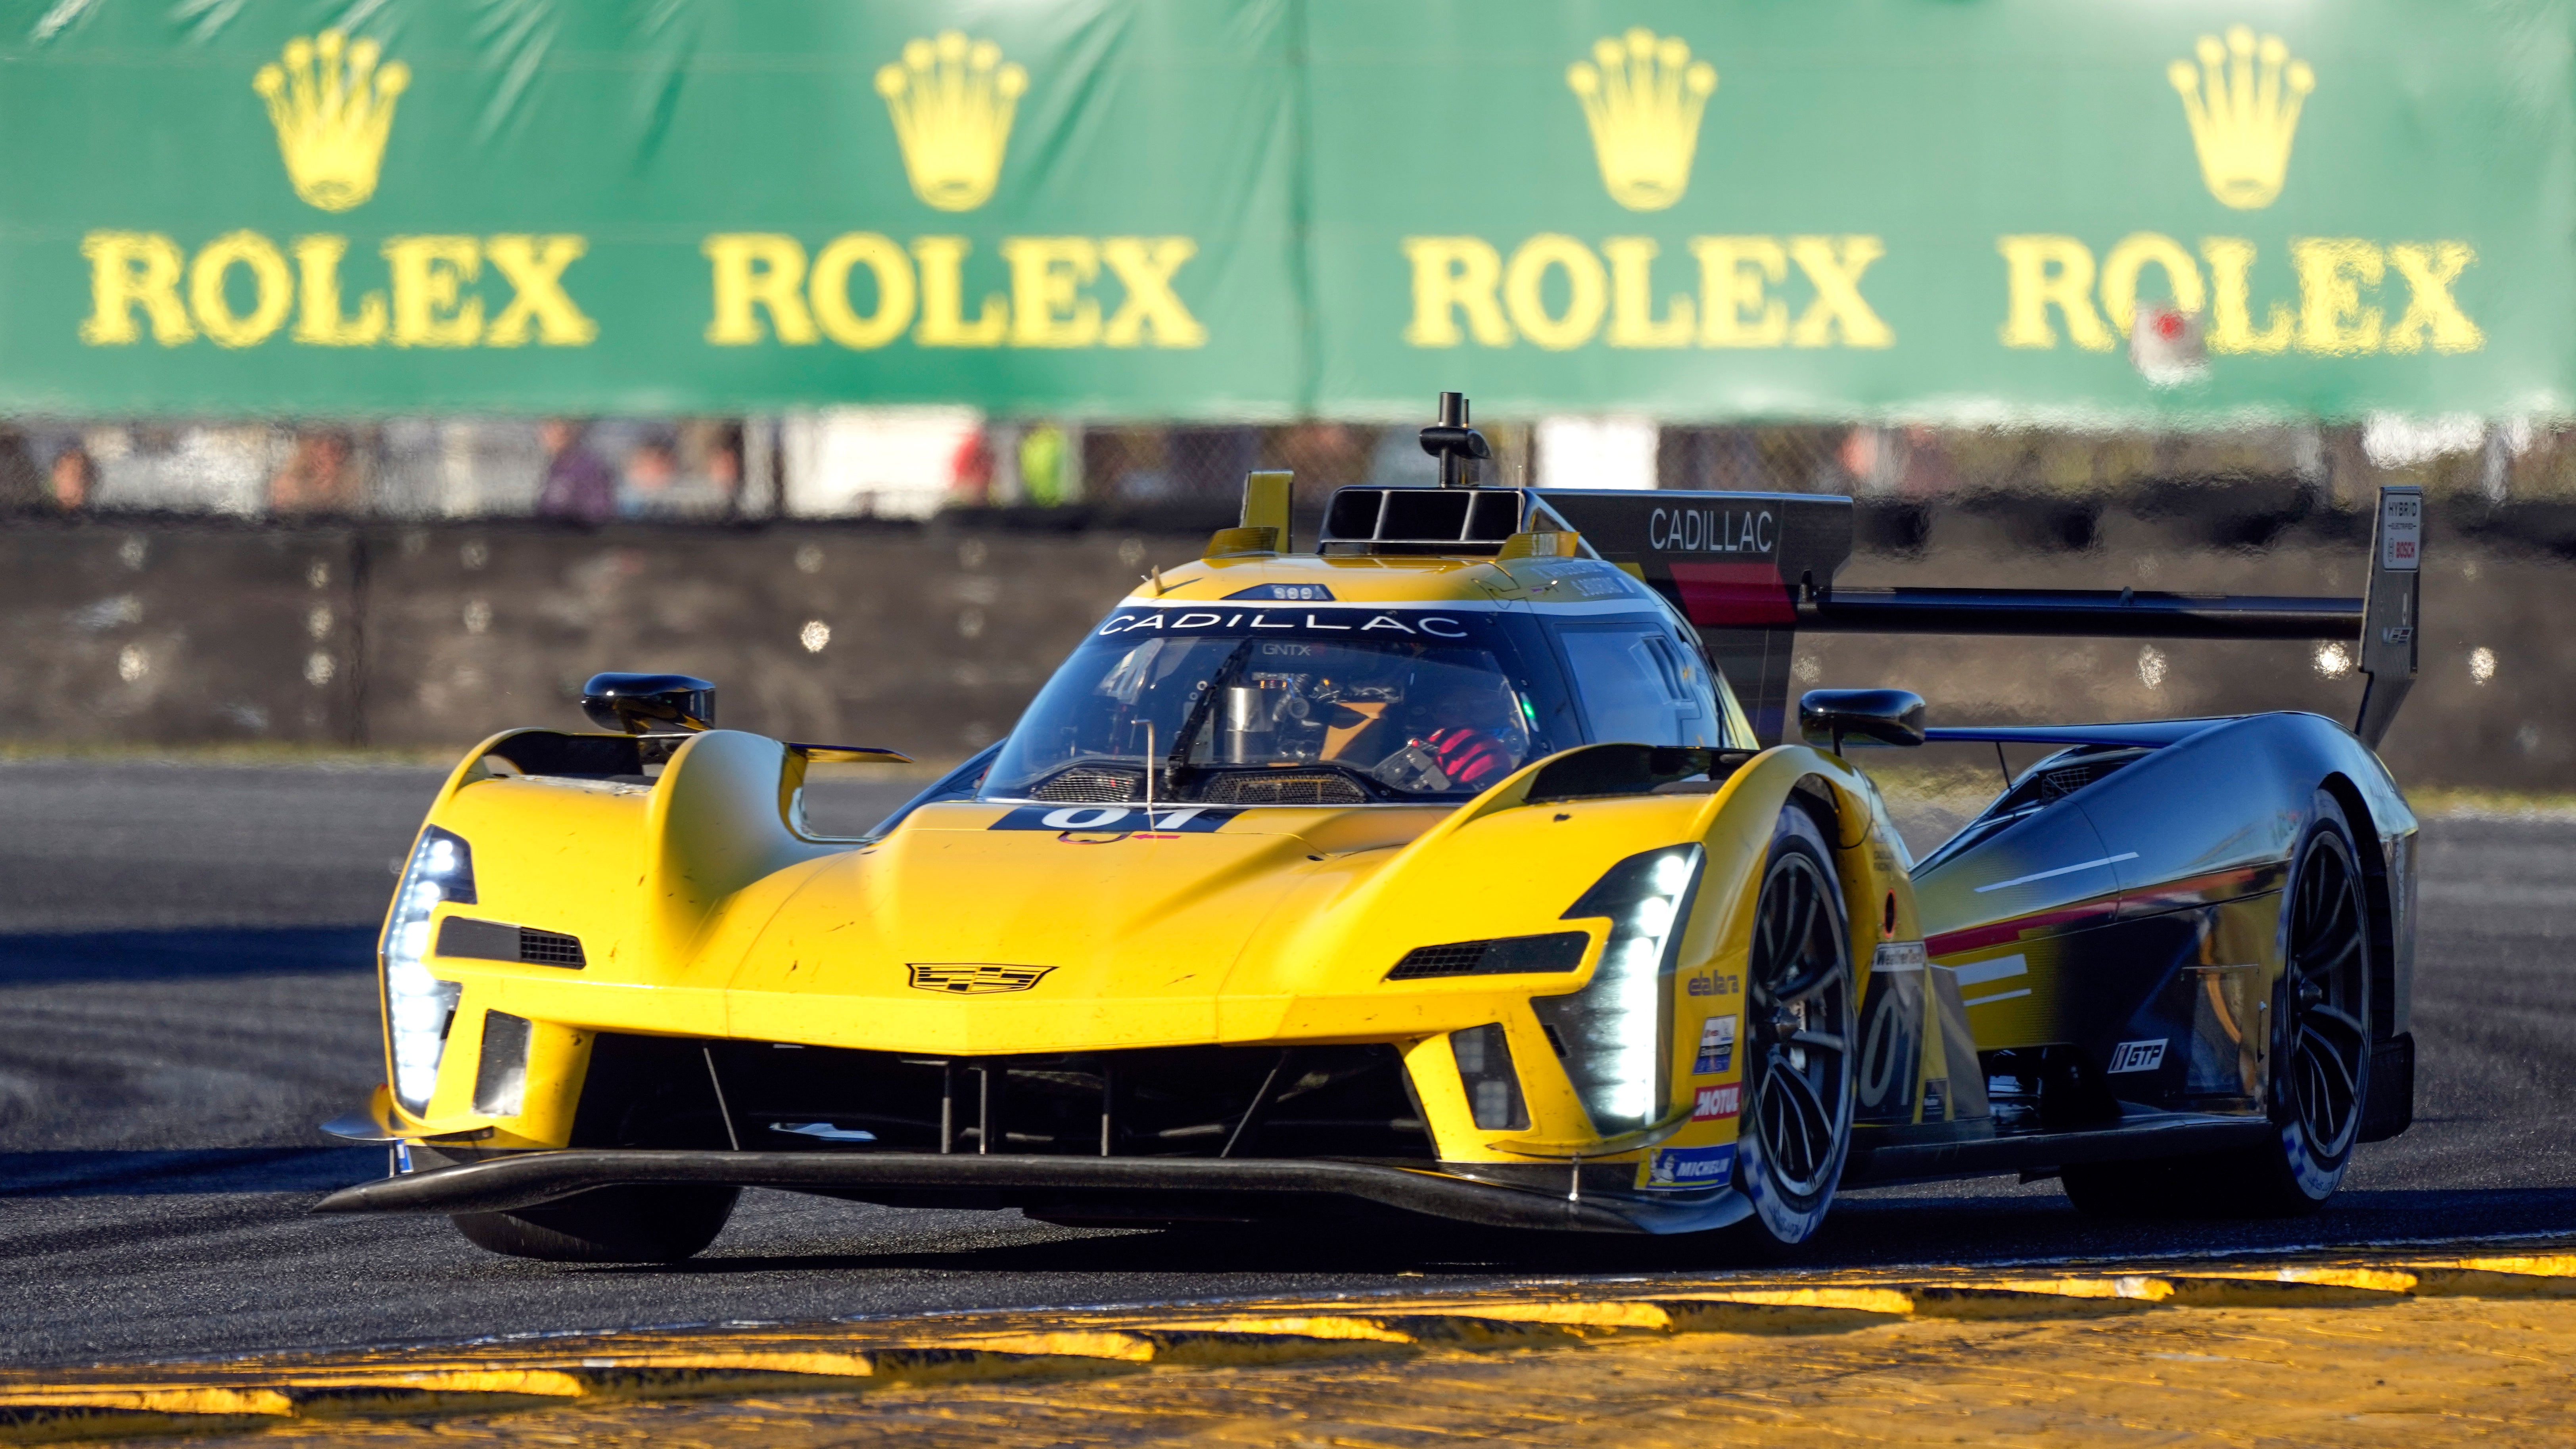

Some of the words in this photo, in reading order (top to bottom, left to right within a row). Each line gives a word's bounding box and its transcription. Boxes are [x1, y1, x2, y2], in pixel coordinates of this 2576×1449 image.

[82, 231, 592, 347] ROLEX
[707, 233, 1206, 348] ROLEX
[1404, 233, 1893, 350] ROLEX
[1998, 232, 2484, 355] ROLEX
[1650, 508, 1772, 552] CADILLAC
[1099, 613, 1468, 637] CADILLAC
[1262, 643, 1310, 656] GNTX
[1042, 807, 1204, 830] 01
[2127, 1045, 2162, 1067] GTP
[1694, 1087, 1740, 1118] MOTUL
[1676, 1158, 1730, 1177] MICHELIN
